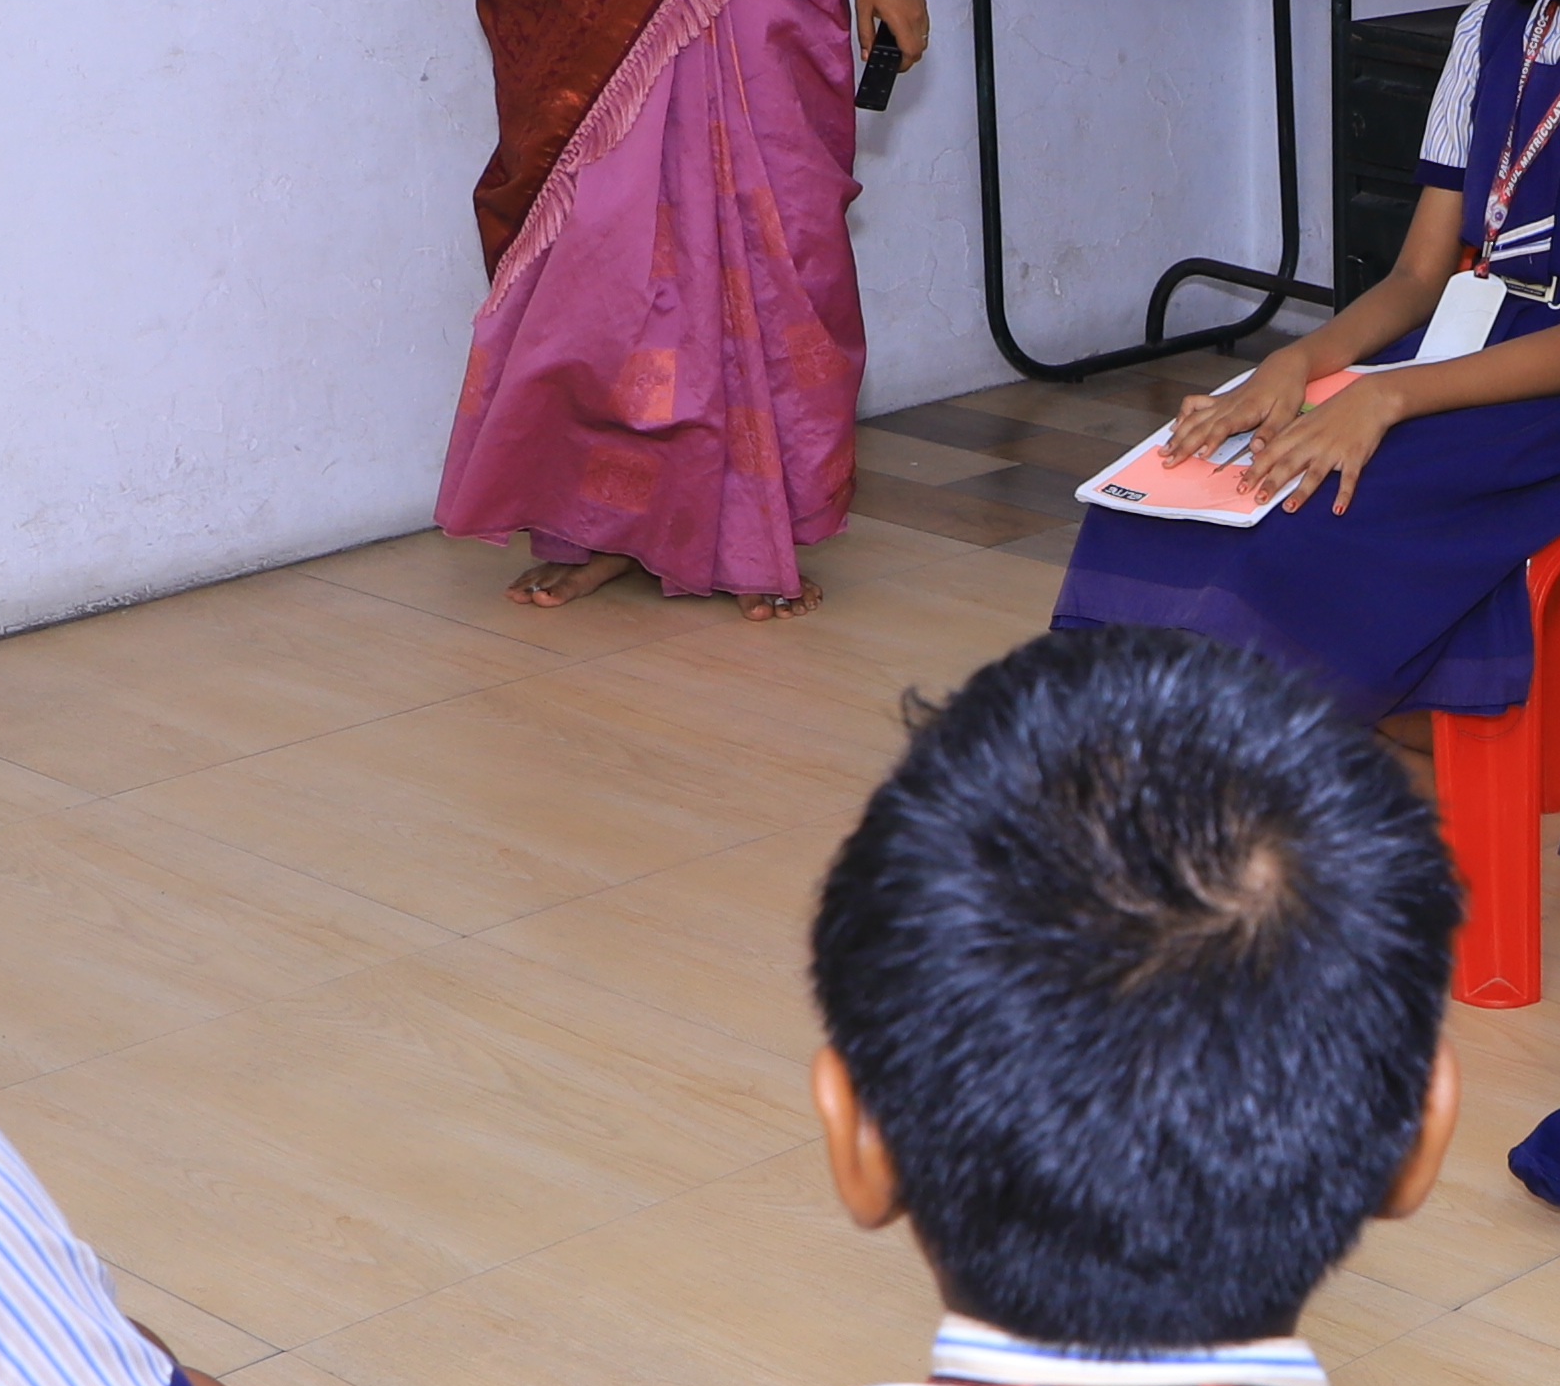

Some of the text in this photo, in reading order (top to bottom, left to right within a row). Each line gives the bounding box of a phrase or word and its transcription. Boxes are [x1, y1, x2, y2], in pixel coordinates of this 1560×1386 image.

[1498, 148, 1512, 180] PAUL
[1527, 13, 1550, 57] SCHOOL
[1504, 169, 1523, 198] PAUL
